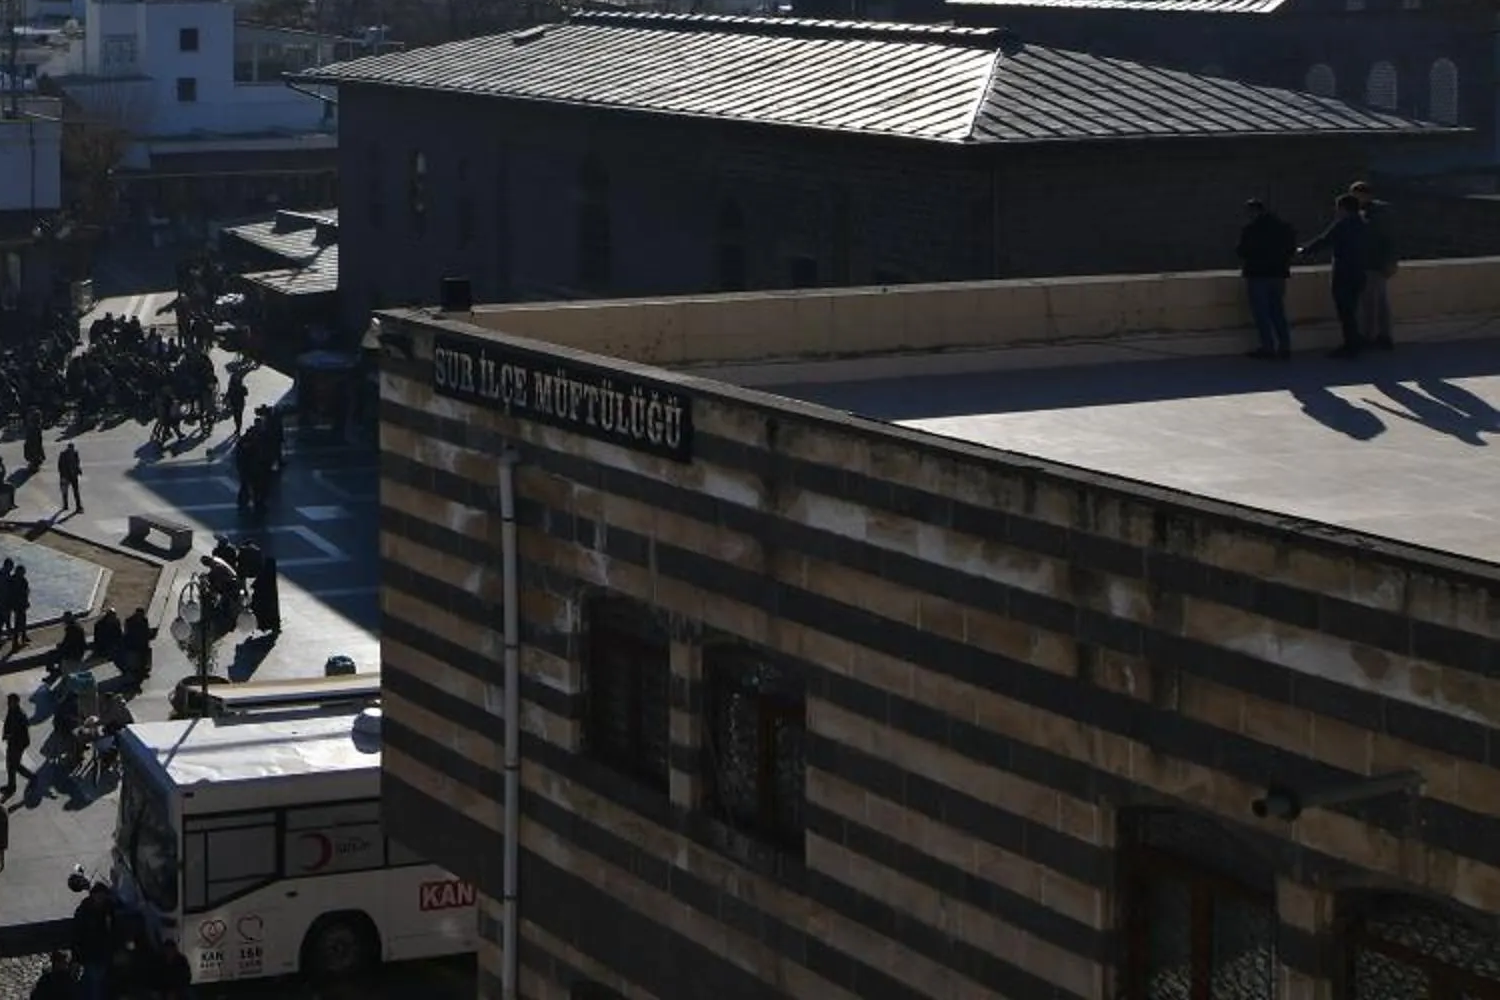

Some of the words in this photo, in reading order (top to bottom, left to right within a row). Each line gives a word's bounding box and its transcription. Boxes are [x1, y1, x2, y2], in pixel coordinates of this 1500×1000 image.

[435, 346, 475, 392] SUR
[479, 348, 527, 413] İLÇE
[534, 367, 683, 449] MÜFTÜLÜĞÜ
[422, 882, 473, 907] KAN
